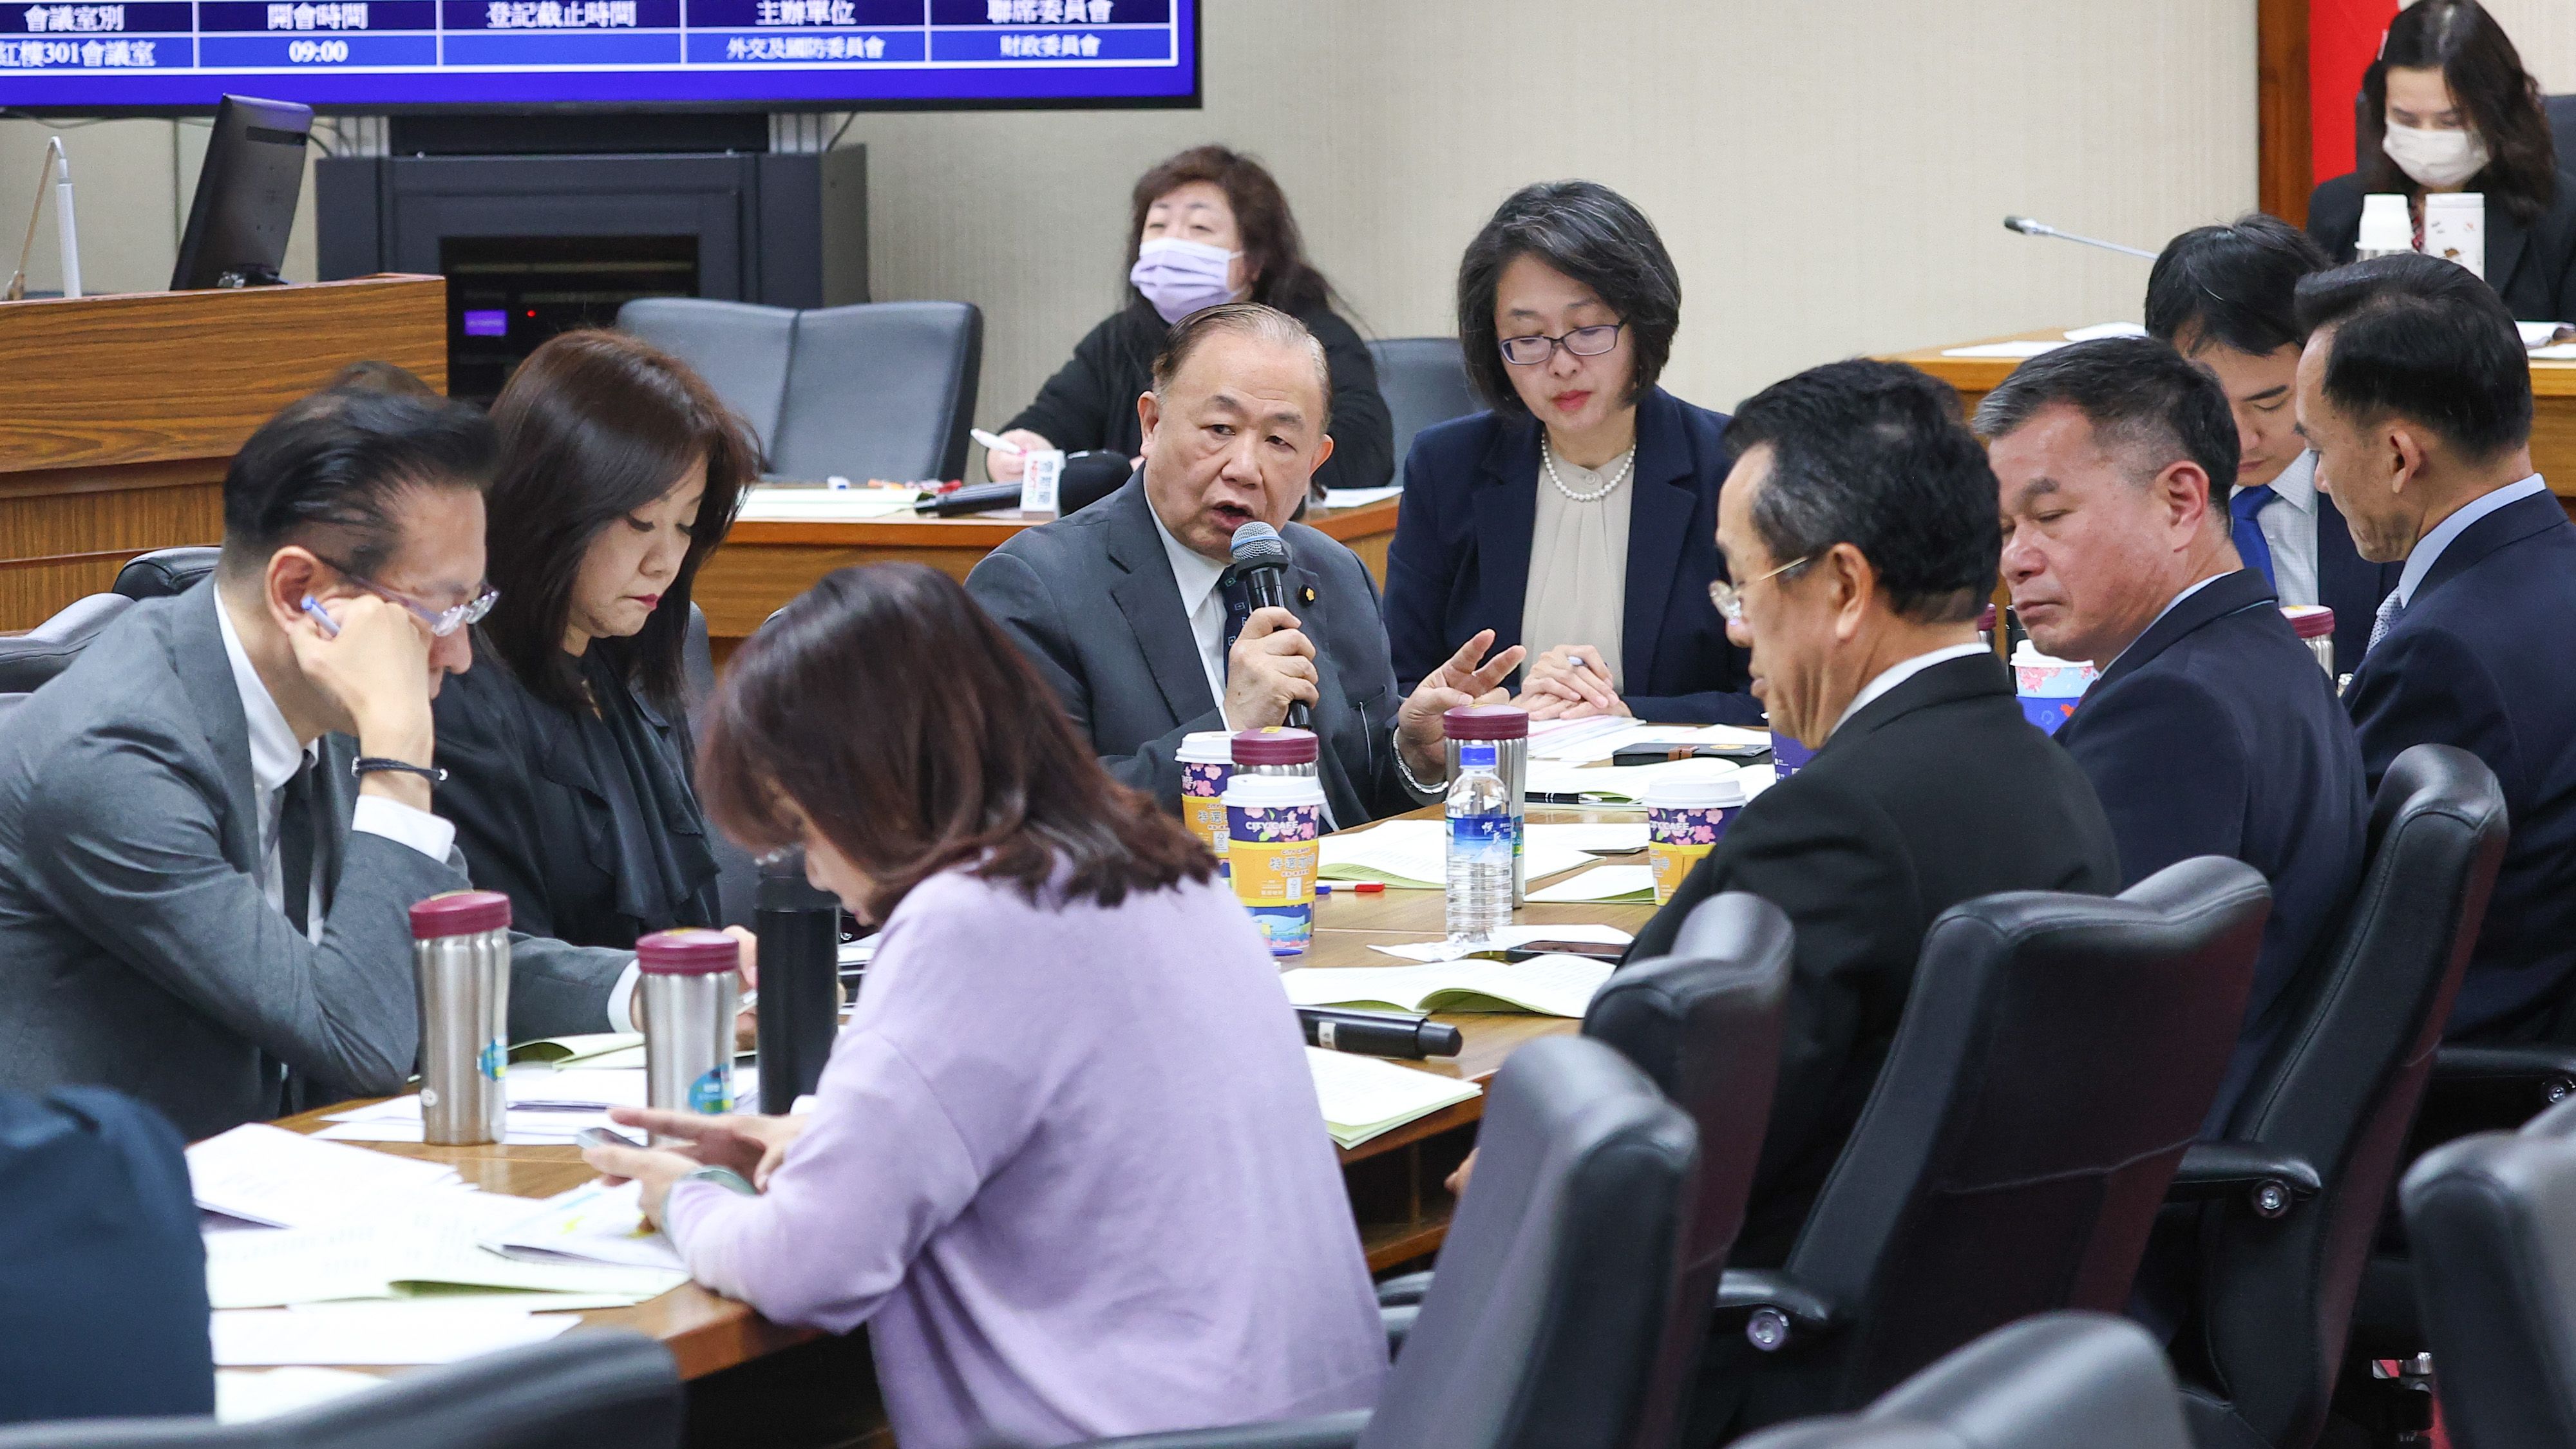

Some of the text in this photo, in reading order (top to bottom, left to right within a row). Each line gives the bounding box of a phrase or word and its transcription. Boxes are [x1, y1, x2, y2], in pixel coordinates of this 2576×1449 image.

[24, 5, 125, 32] 會議室別
[267, 2, 368, 30] 開會時間
[486, 0, 637, 28] 登記截止時間
[755, 0, 857, 25] 主辦單位
[987, 0, 1113, 24] 聯席委員會
[289, 40, 348, 62] 09:00
[726, 35, 886, 60] 外交及國防委員會
[999, 33, 1101, 57] 財政委員會
[1245, 820, 1299, 831] CITY CAFE
